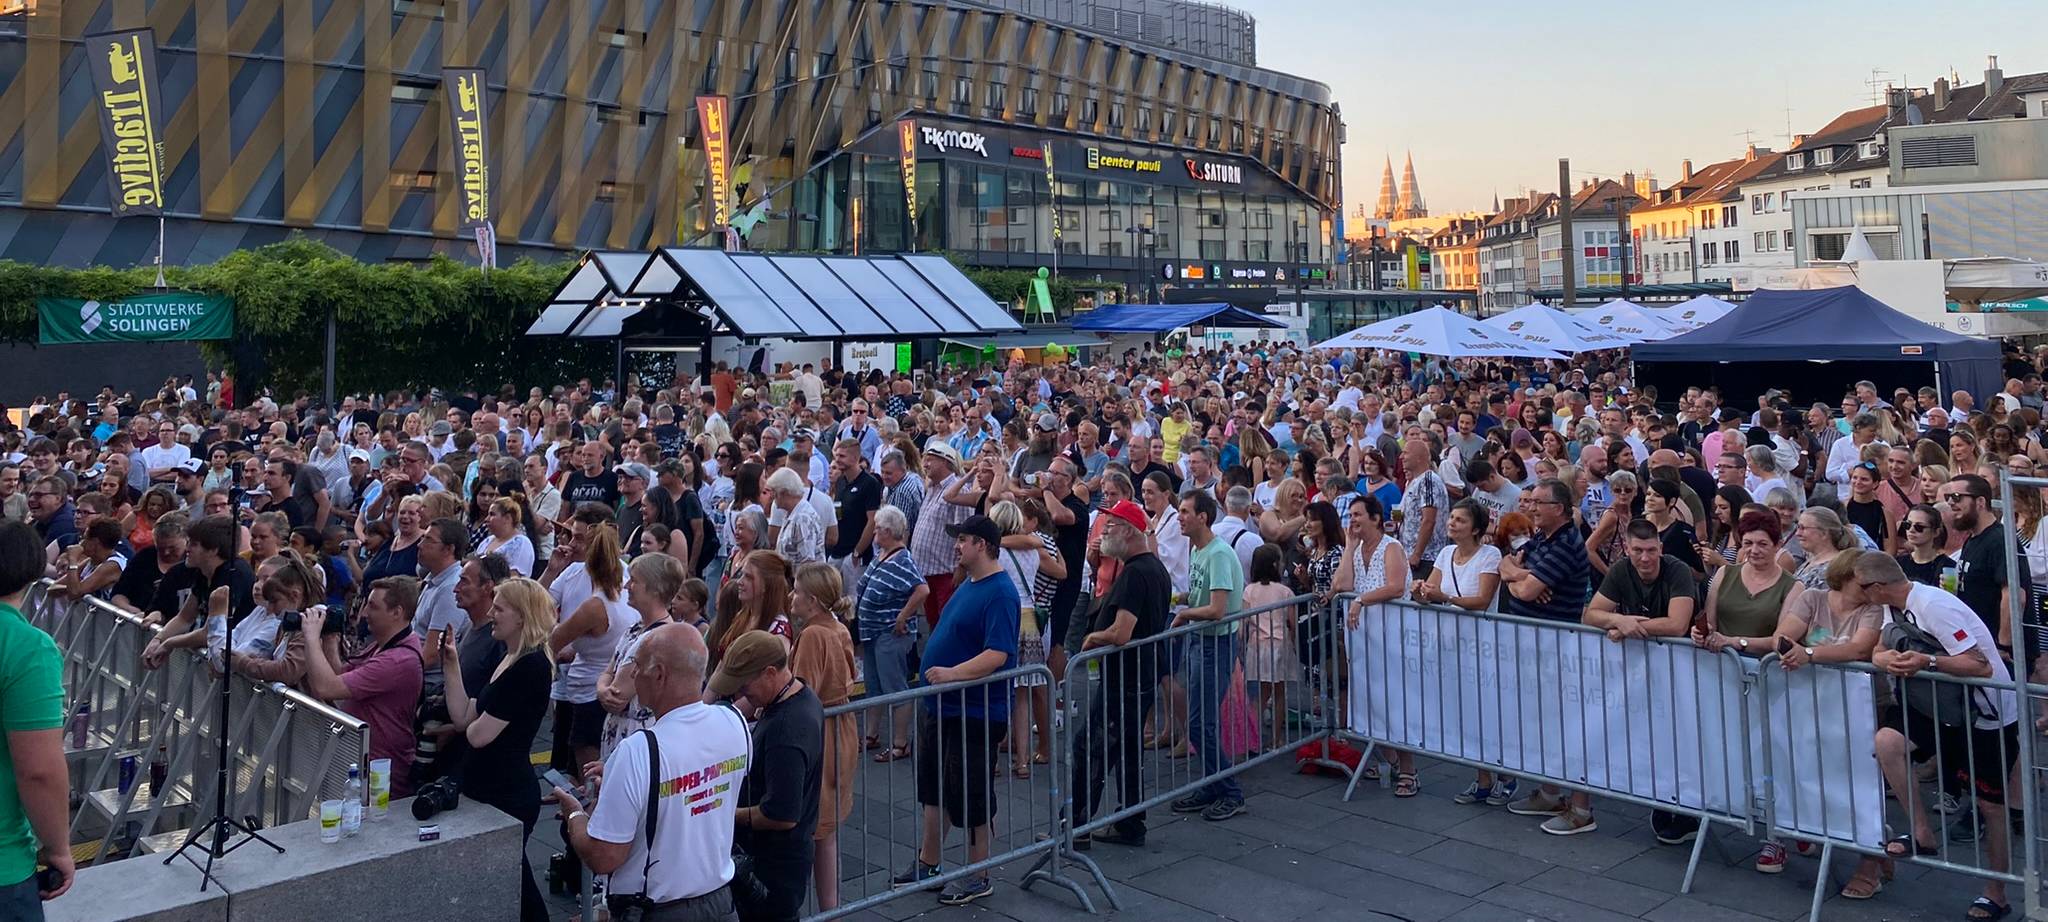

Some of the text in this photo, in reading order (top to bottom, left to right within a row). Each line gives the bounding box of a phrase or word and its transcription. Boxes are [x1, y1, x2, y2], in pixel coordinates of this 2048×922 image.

[1100, 155, 1135, 169] center
[1136, 159, 1161, 172] pauli
[1204, 161, 1241, 184] SATURN
[108, 303, 204, 316] STADTWERKE
[109, 318, 190, 332] SOLINGEN
